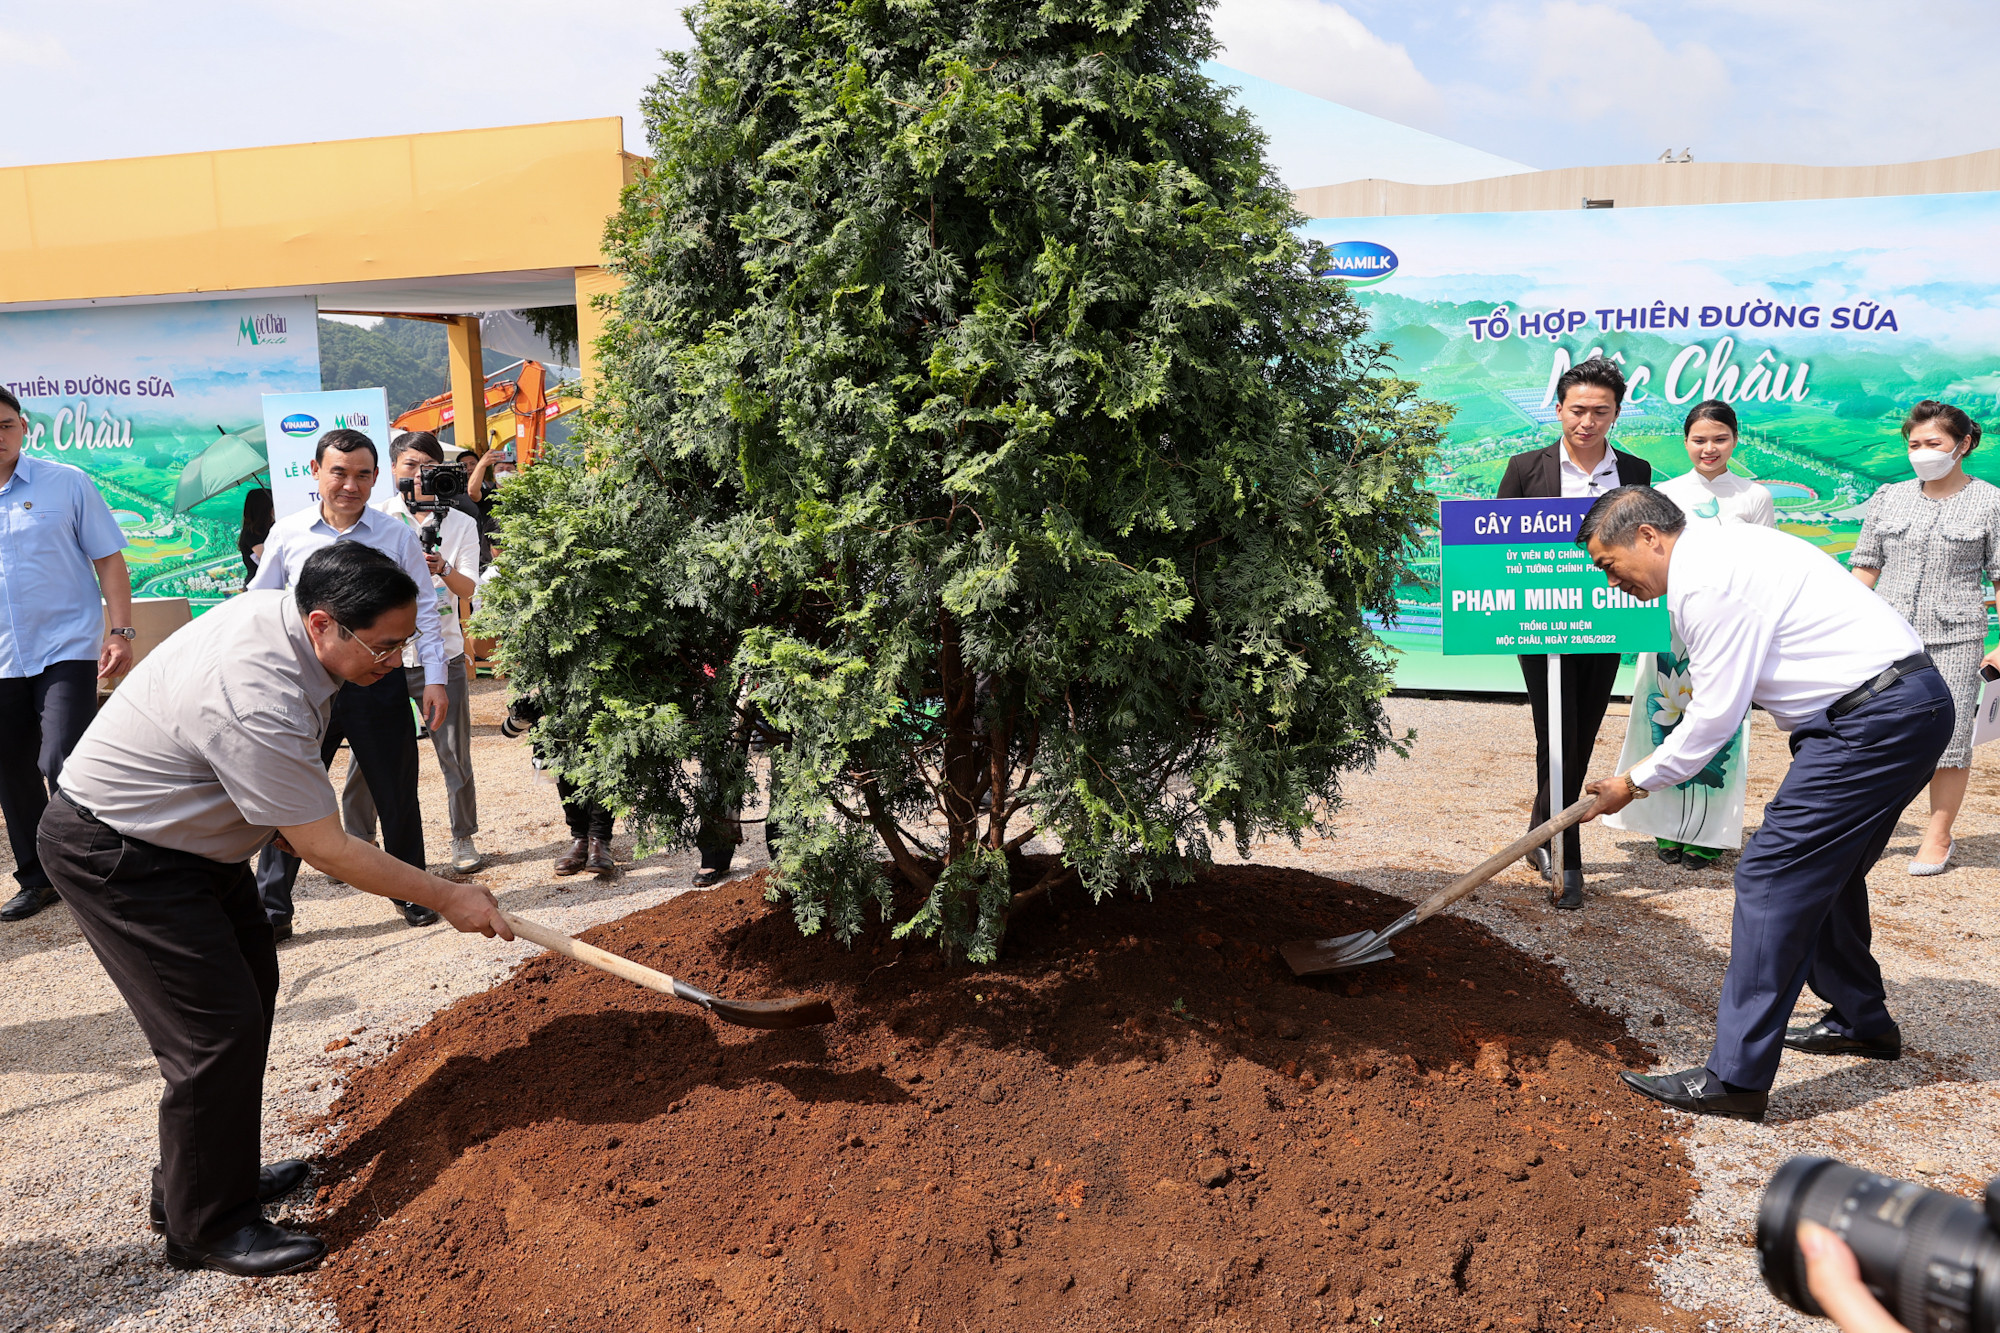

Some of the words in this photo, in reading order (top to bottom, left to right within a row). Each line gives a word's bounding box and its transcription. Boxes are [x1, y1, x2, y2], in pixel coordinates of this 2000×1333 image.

[1469, 308, 1509, 340] TỔ
[1520, 308, 1586, 340] HỢP
[1595, 300, 1689, 330] THIÊN
[1699, 298, 1820, 328] ĐƯỜNG
[1830, 302, 1898, 331] SỮA
[1665, 336, 1810, 405] Châu
[7, 376, 60, 397] THIÊN
[64, 375, 131, 395] ĐƯỜNG
[137, 376, 175, 398] SỮA
[53, 401, 134, 451] Châu
[283, 421, 317, 430] VINAMILK
[285, 461, 299, 478] LỄ
[1474, 512, 1512, 534] CÂY
[1520, 510, 1572, 534] BÁCH
[1506, 549, 1518, 560] ỦY
[1521, 550, 1541, 560] VIÊN
[1544, 549, 1555, 561] BỘ
[1558, 549, 1585, 559] CHÍNH
[1506, 563, 1523, 573] THỦ
[1556, 563, 1583, 573] CHÍNH
[1452, 589, 1516, 616] PHẠM
[1525, 587, 1583, 610] MINH
[1550, 621, 1567, 630] LƯU
[1570, 620, 1592, 632] NIỆM
[1496, 635, 1515, 646] MỘC
[1518, 635, 1543, 645] CHÂU,
[1545, 634, 1568, 645] NGÀY
[1571, 635, 1616, 645] 28/05/2022
